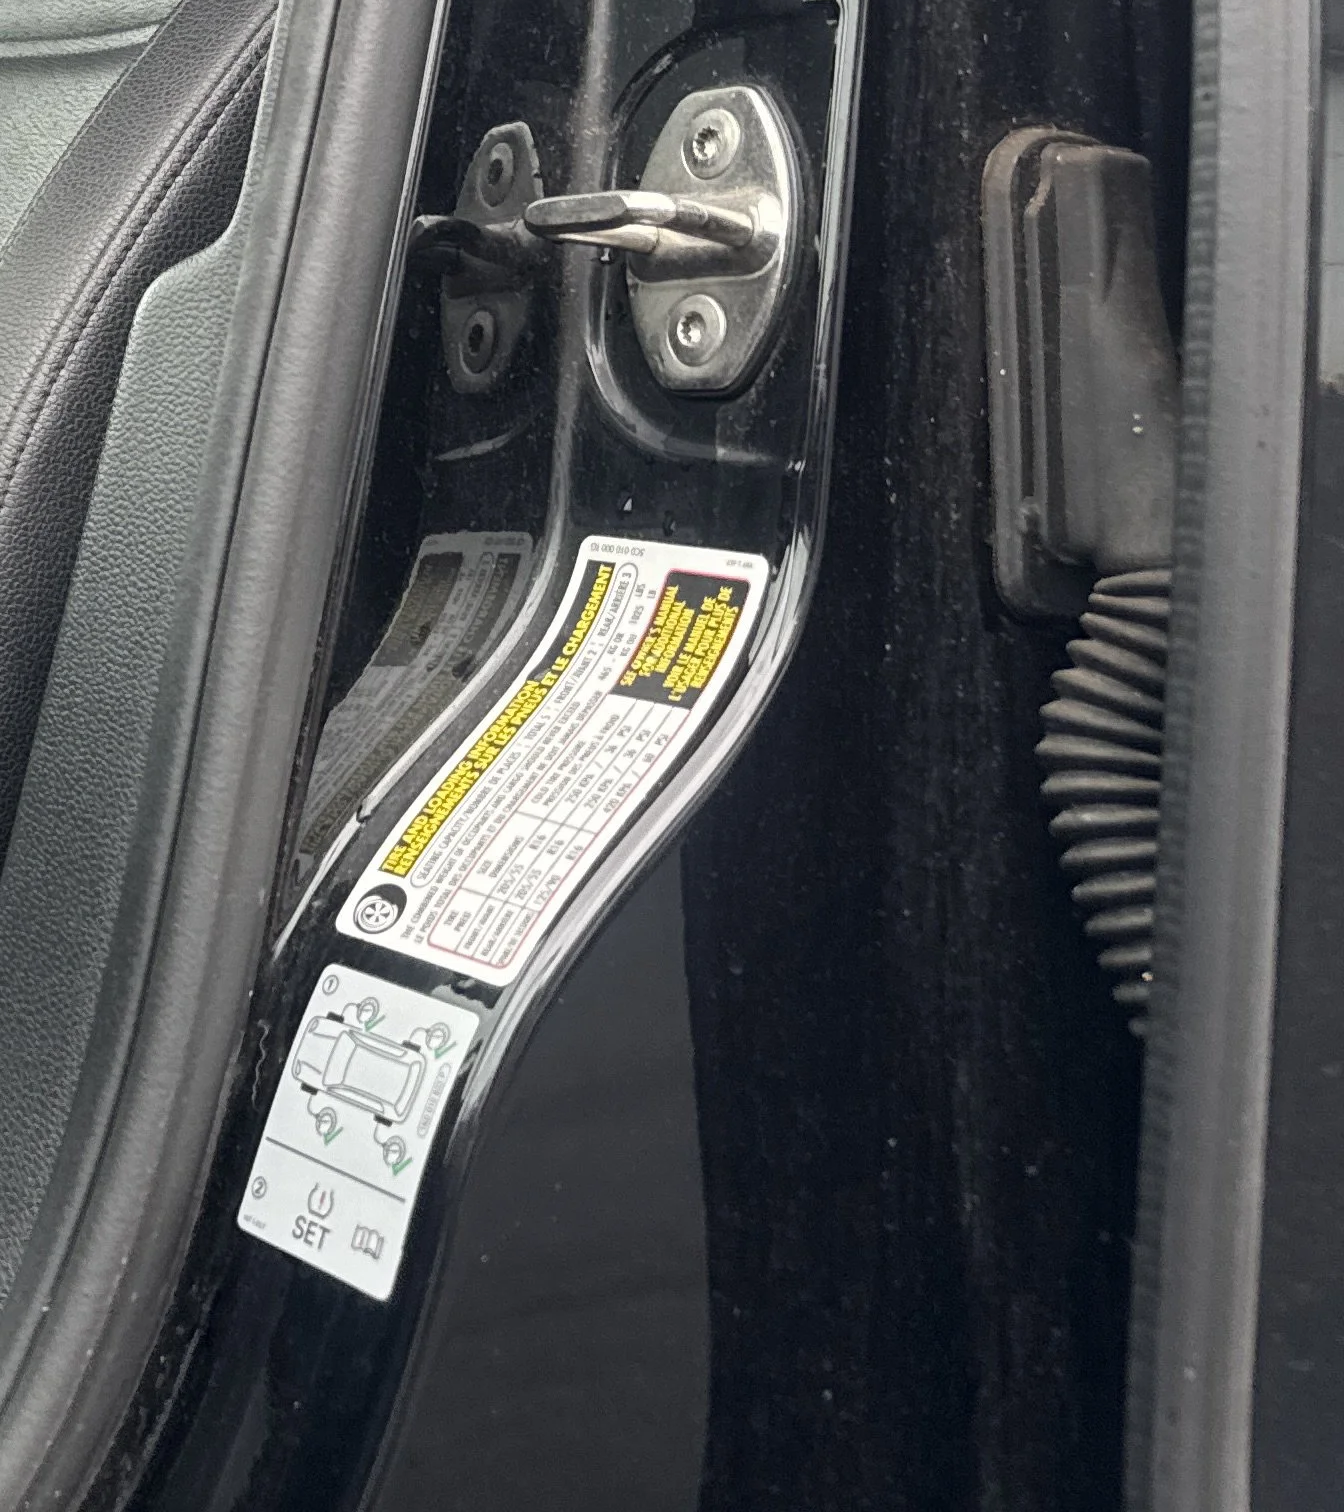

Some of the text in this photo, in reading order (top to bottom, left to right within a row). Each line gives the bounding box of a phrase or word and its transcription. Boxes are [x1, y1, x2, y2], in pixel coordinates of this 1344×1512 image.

[652, 583, 679, 626] MANUAL
[700, 595, 716, 612] DE
[716, 585, 733, 601] DE
[650, 600, 687, 656] ADDITIONAL
[682, 612, 711, 653] MANUEL
[707, 601, 728, 628] PLUS
[653, 606, 695, 673] INFORMATION
[675, 651, 692, 665] LE
[693, 627, 717, 656] POUR
[392, 563, 612, 875] RENSEIGNEMENTS SUR LES PNEUS ET LE CHARGEMENT
[380, 680, 540, 871] TIRE AND LOADING INFORMATION
[292, 1214, 331, 1251] SET
